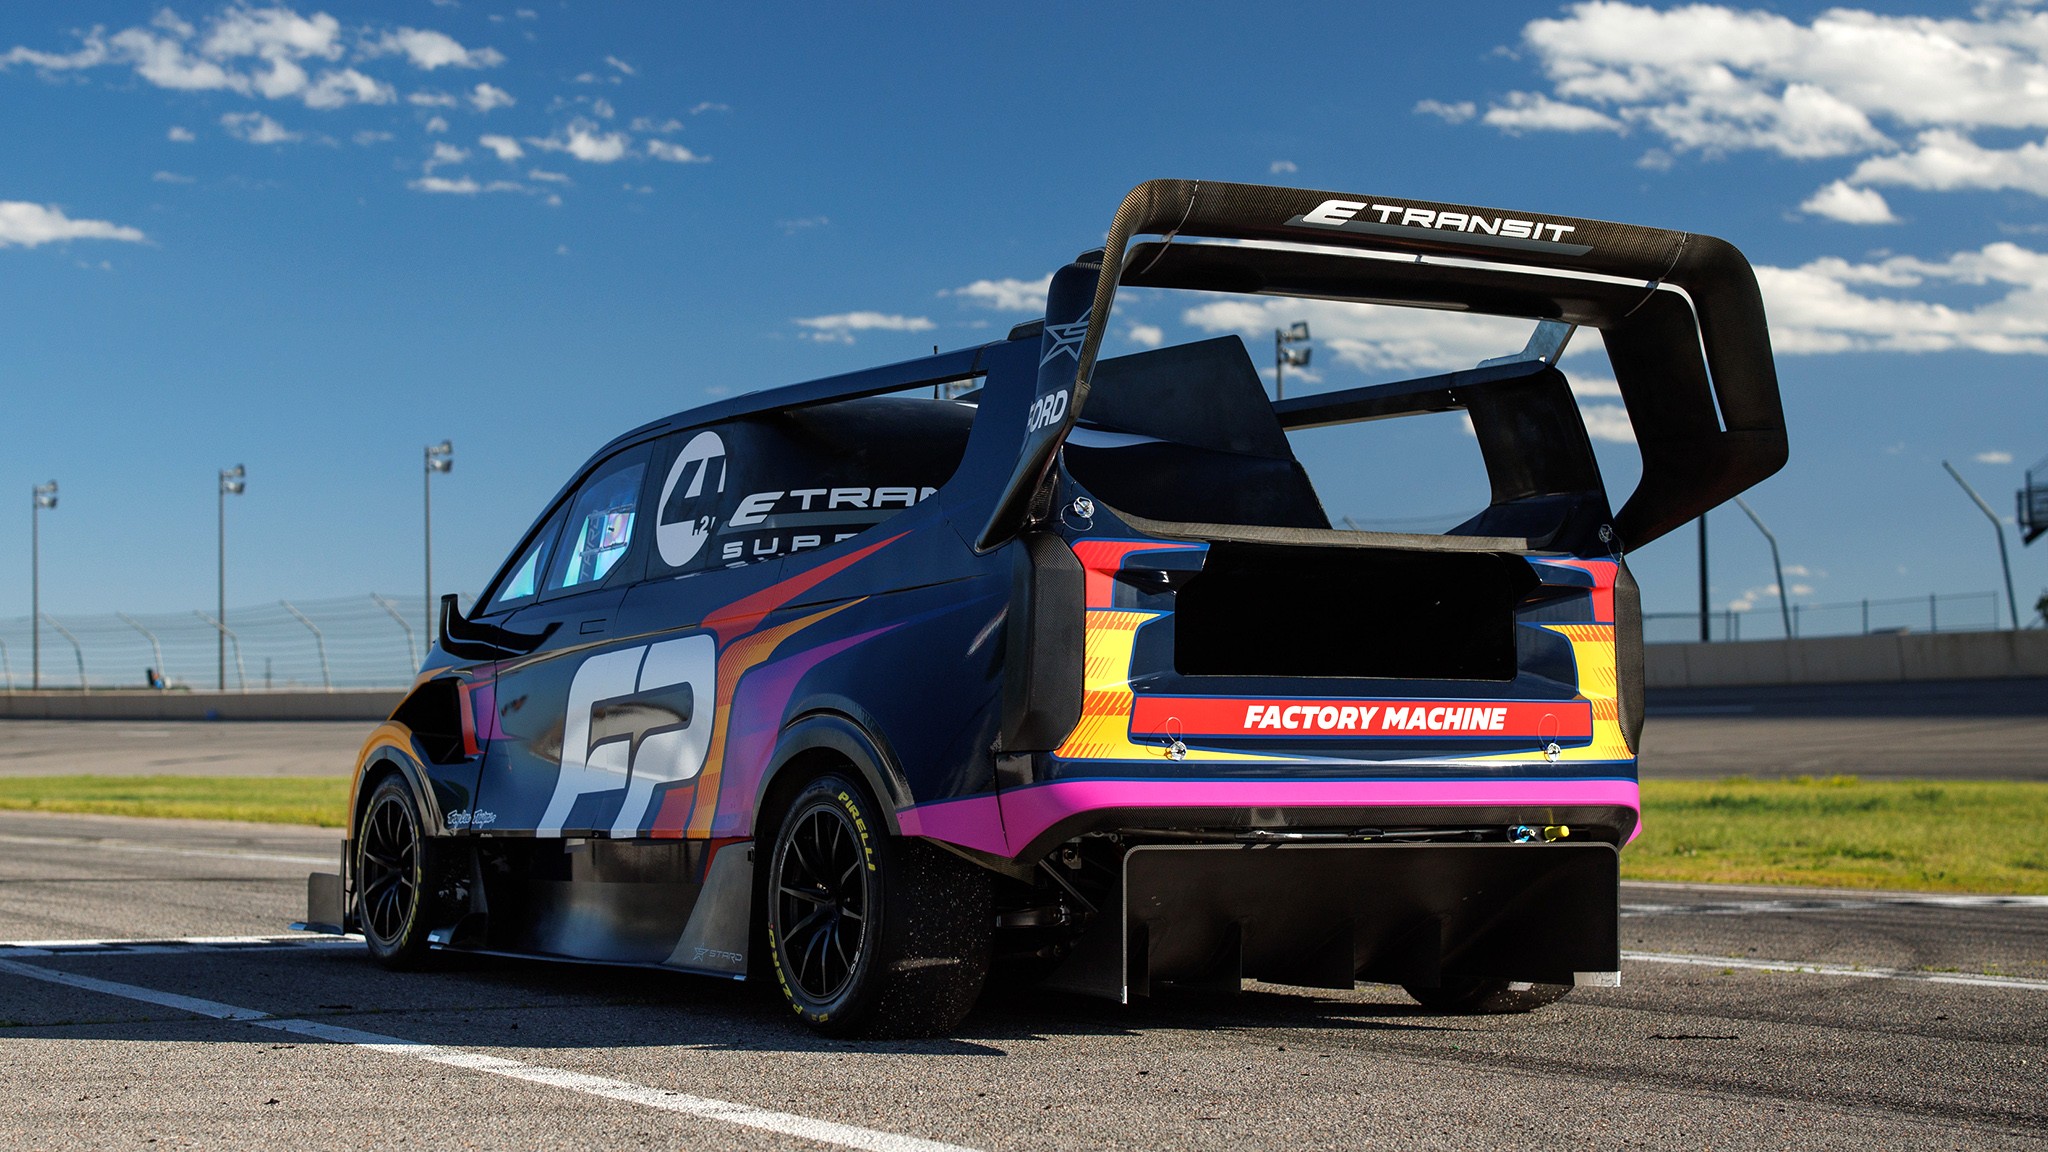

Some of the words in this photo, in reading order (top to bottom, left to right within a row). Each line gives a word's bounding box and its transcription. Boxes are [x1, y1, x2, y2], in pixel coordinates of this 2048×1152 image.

[1302, 199, 1367, 226] E
[1371, 203, 1576, 242] TRANSIT
[729, 490, 785, 527] E
[1243, 704, 1379, 730] FACTORY
[1381, 706, 1508, 731] MACHINE
[837, 791, 877, 872] PIRELLI
[709, 949, 743, 965] STARD
